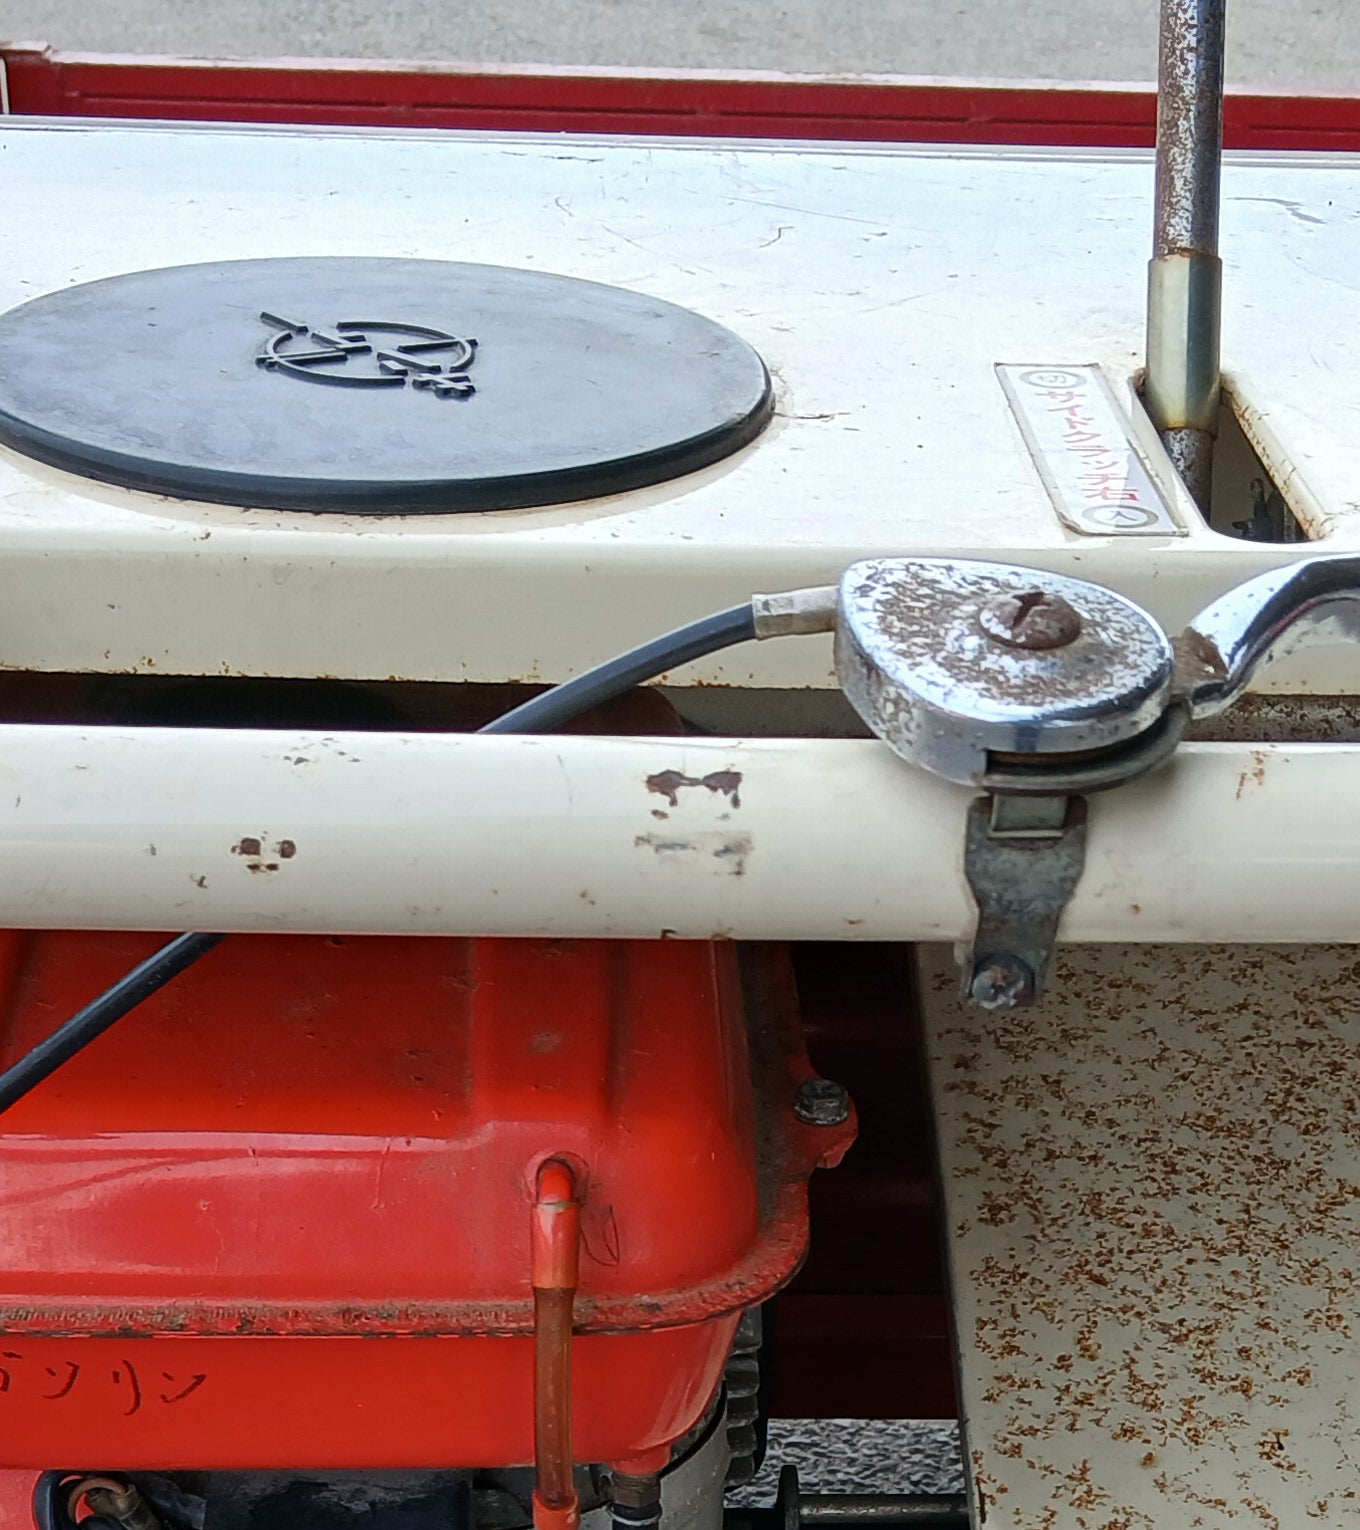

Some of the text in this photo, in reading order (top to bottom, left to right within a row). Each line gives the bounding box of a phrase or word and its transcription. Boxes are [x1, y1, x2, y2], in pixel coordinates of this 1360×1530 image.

[1034, 391, 1139, 501] サイドクラッチ右
